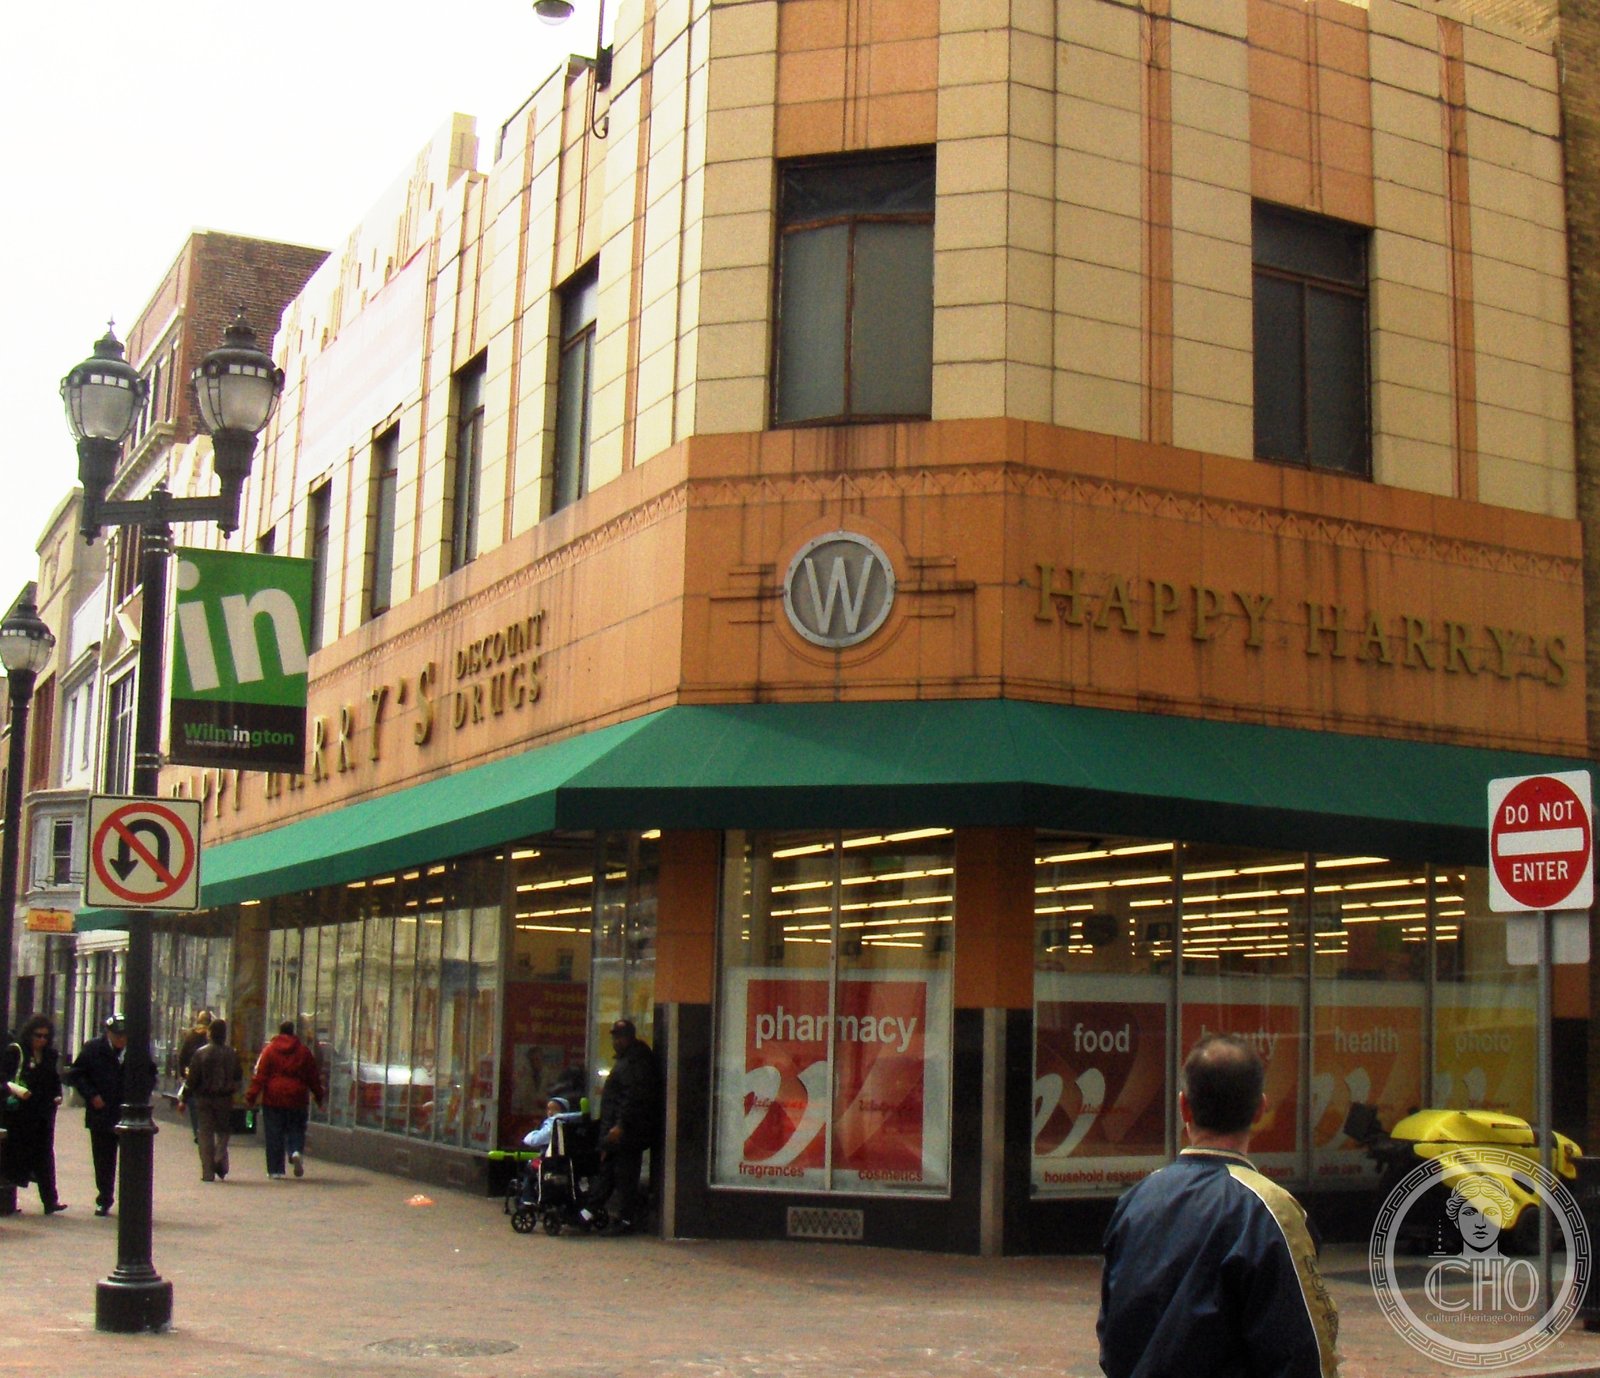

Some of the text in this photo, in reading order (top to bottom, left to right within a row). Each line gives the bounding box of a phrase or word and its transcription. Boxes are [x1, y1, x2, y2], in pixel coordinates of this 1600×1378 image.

[804, 554, 874, 635] W
[176, 560, 309, 692] in
[1035, 564, 1569, 687] HAPPY HARRY'S
[456, 609, 546, 680] DISCOUNT
[454, 655, 542, 730] DRUGS
[184, 723, 296, 748] Wilmington
[1505, 800, 1575, 825] DO NOT
[1512, 860, 1569, 883] ENTER
[756, 1006, 917, 1053] pharmacy
[1073, 1023, 1130, 1054] food
[1335, 1026, 1400, 1055] health
[1456, 1028, 1512, 1059] photo
[738, 1161, 805, 1179] fragrances
[858, 1168, 923, 1183] cosmetics
[1043, 1169, 1104, 1184] household
